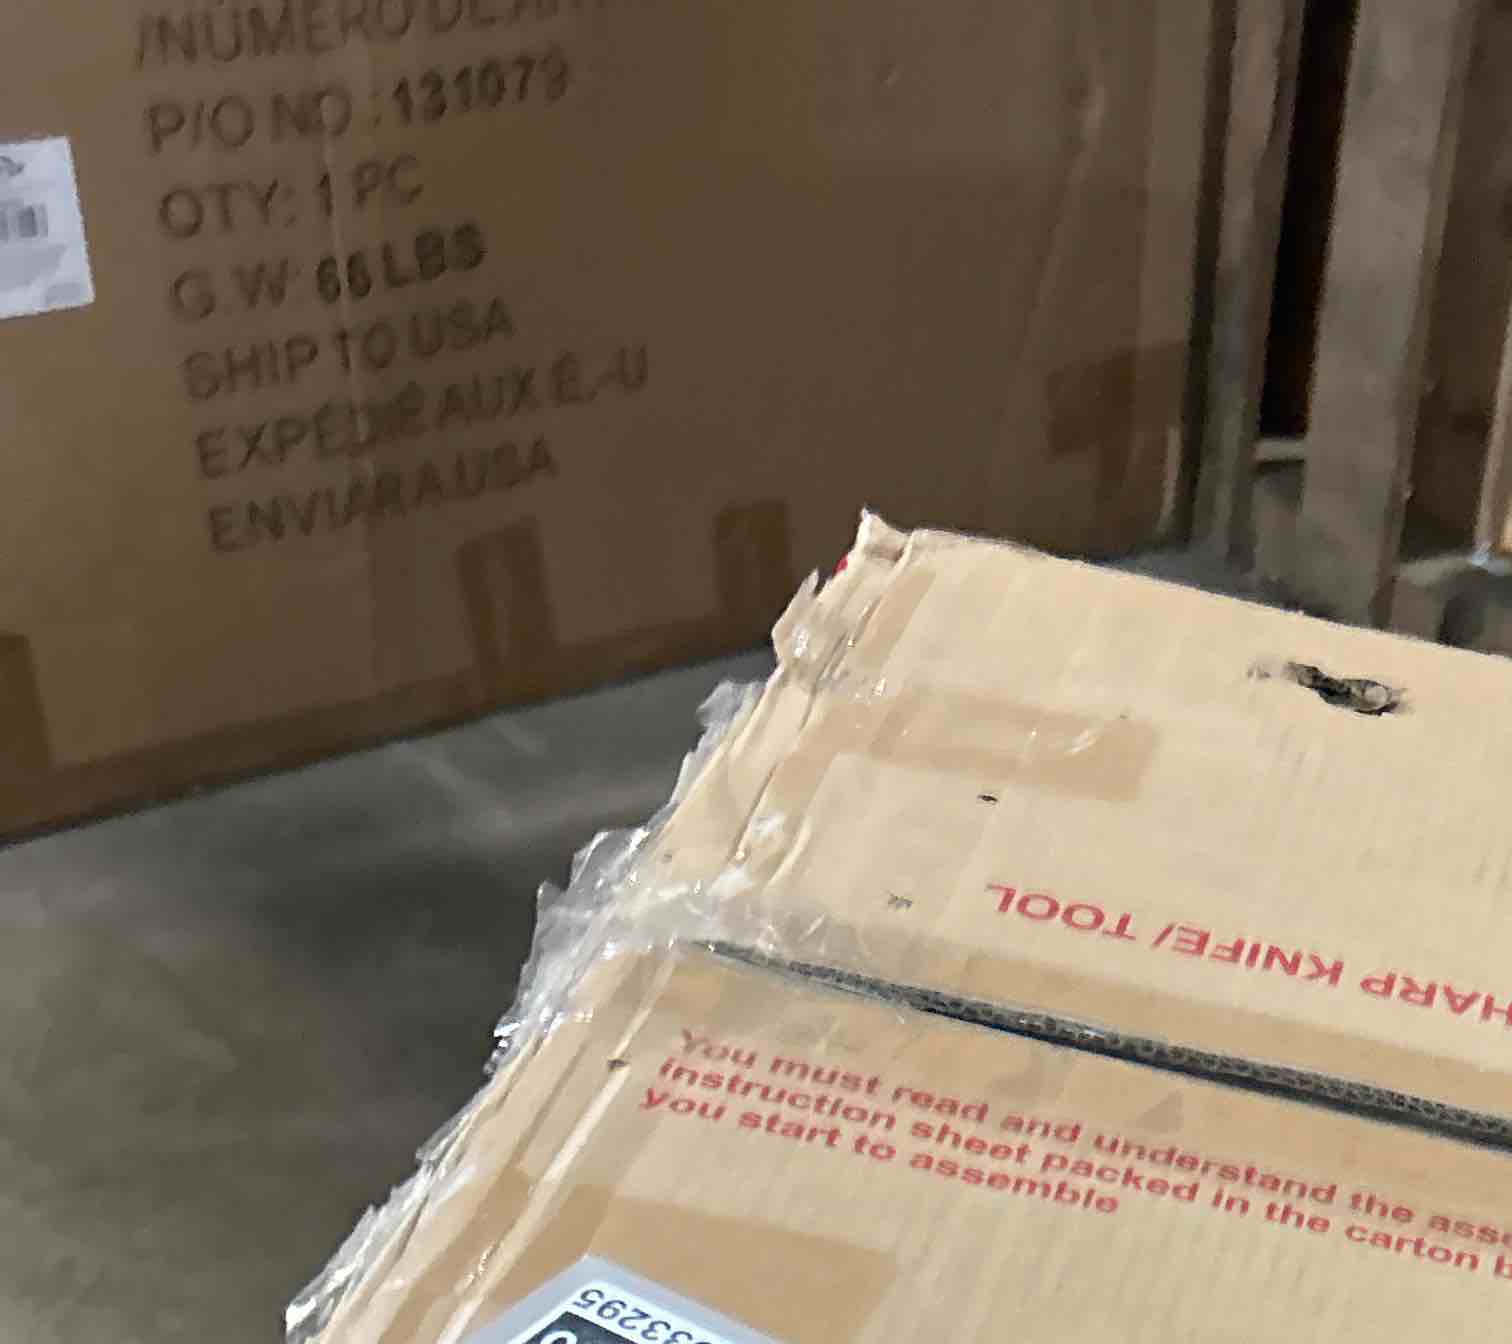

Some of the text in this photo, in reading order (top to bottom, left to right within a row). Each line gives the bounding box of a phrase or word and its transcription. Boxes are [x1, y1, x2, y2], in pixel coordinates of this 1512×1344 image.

[353, 153, 424, 212] PC
[182, 298, 514, 400] SHIP TO USA
[985, 881, 1137, 943] TOOL
[1153, 920, 1343, 987] KNIFE/
[639, 1086, 1120, 1216] you start to assemble
[658, 1056, 897, 1131] instruction
[909, 1118, 1032, 1166] sheet
[1041, 1151, 1199, 1203] packed
[1211, 1188, 1250, 1218] in
[1263, 1200, 1331, 1235] the
[1345, 1222, 1481, 1273] carton
[680, 1027, 757, 1070] You
[769, 1055, 881, 1097] must
[892, 1083, 989, 1124] read
[1000, 1111, 1082, 1145] and
[1093, 1133, 1338, 1204] understand
[1349, 1188, 1415, 1225] the
